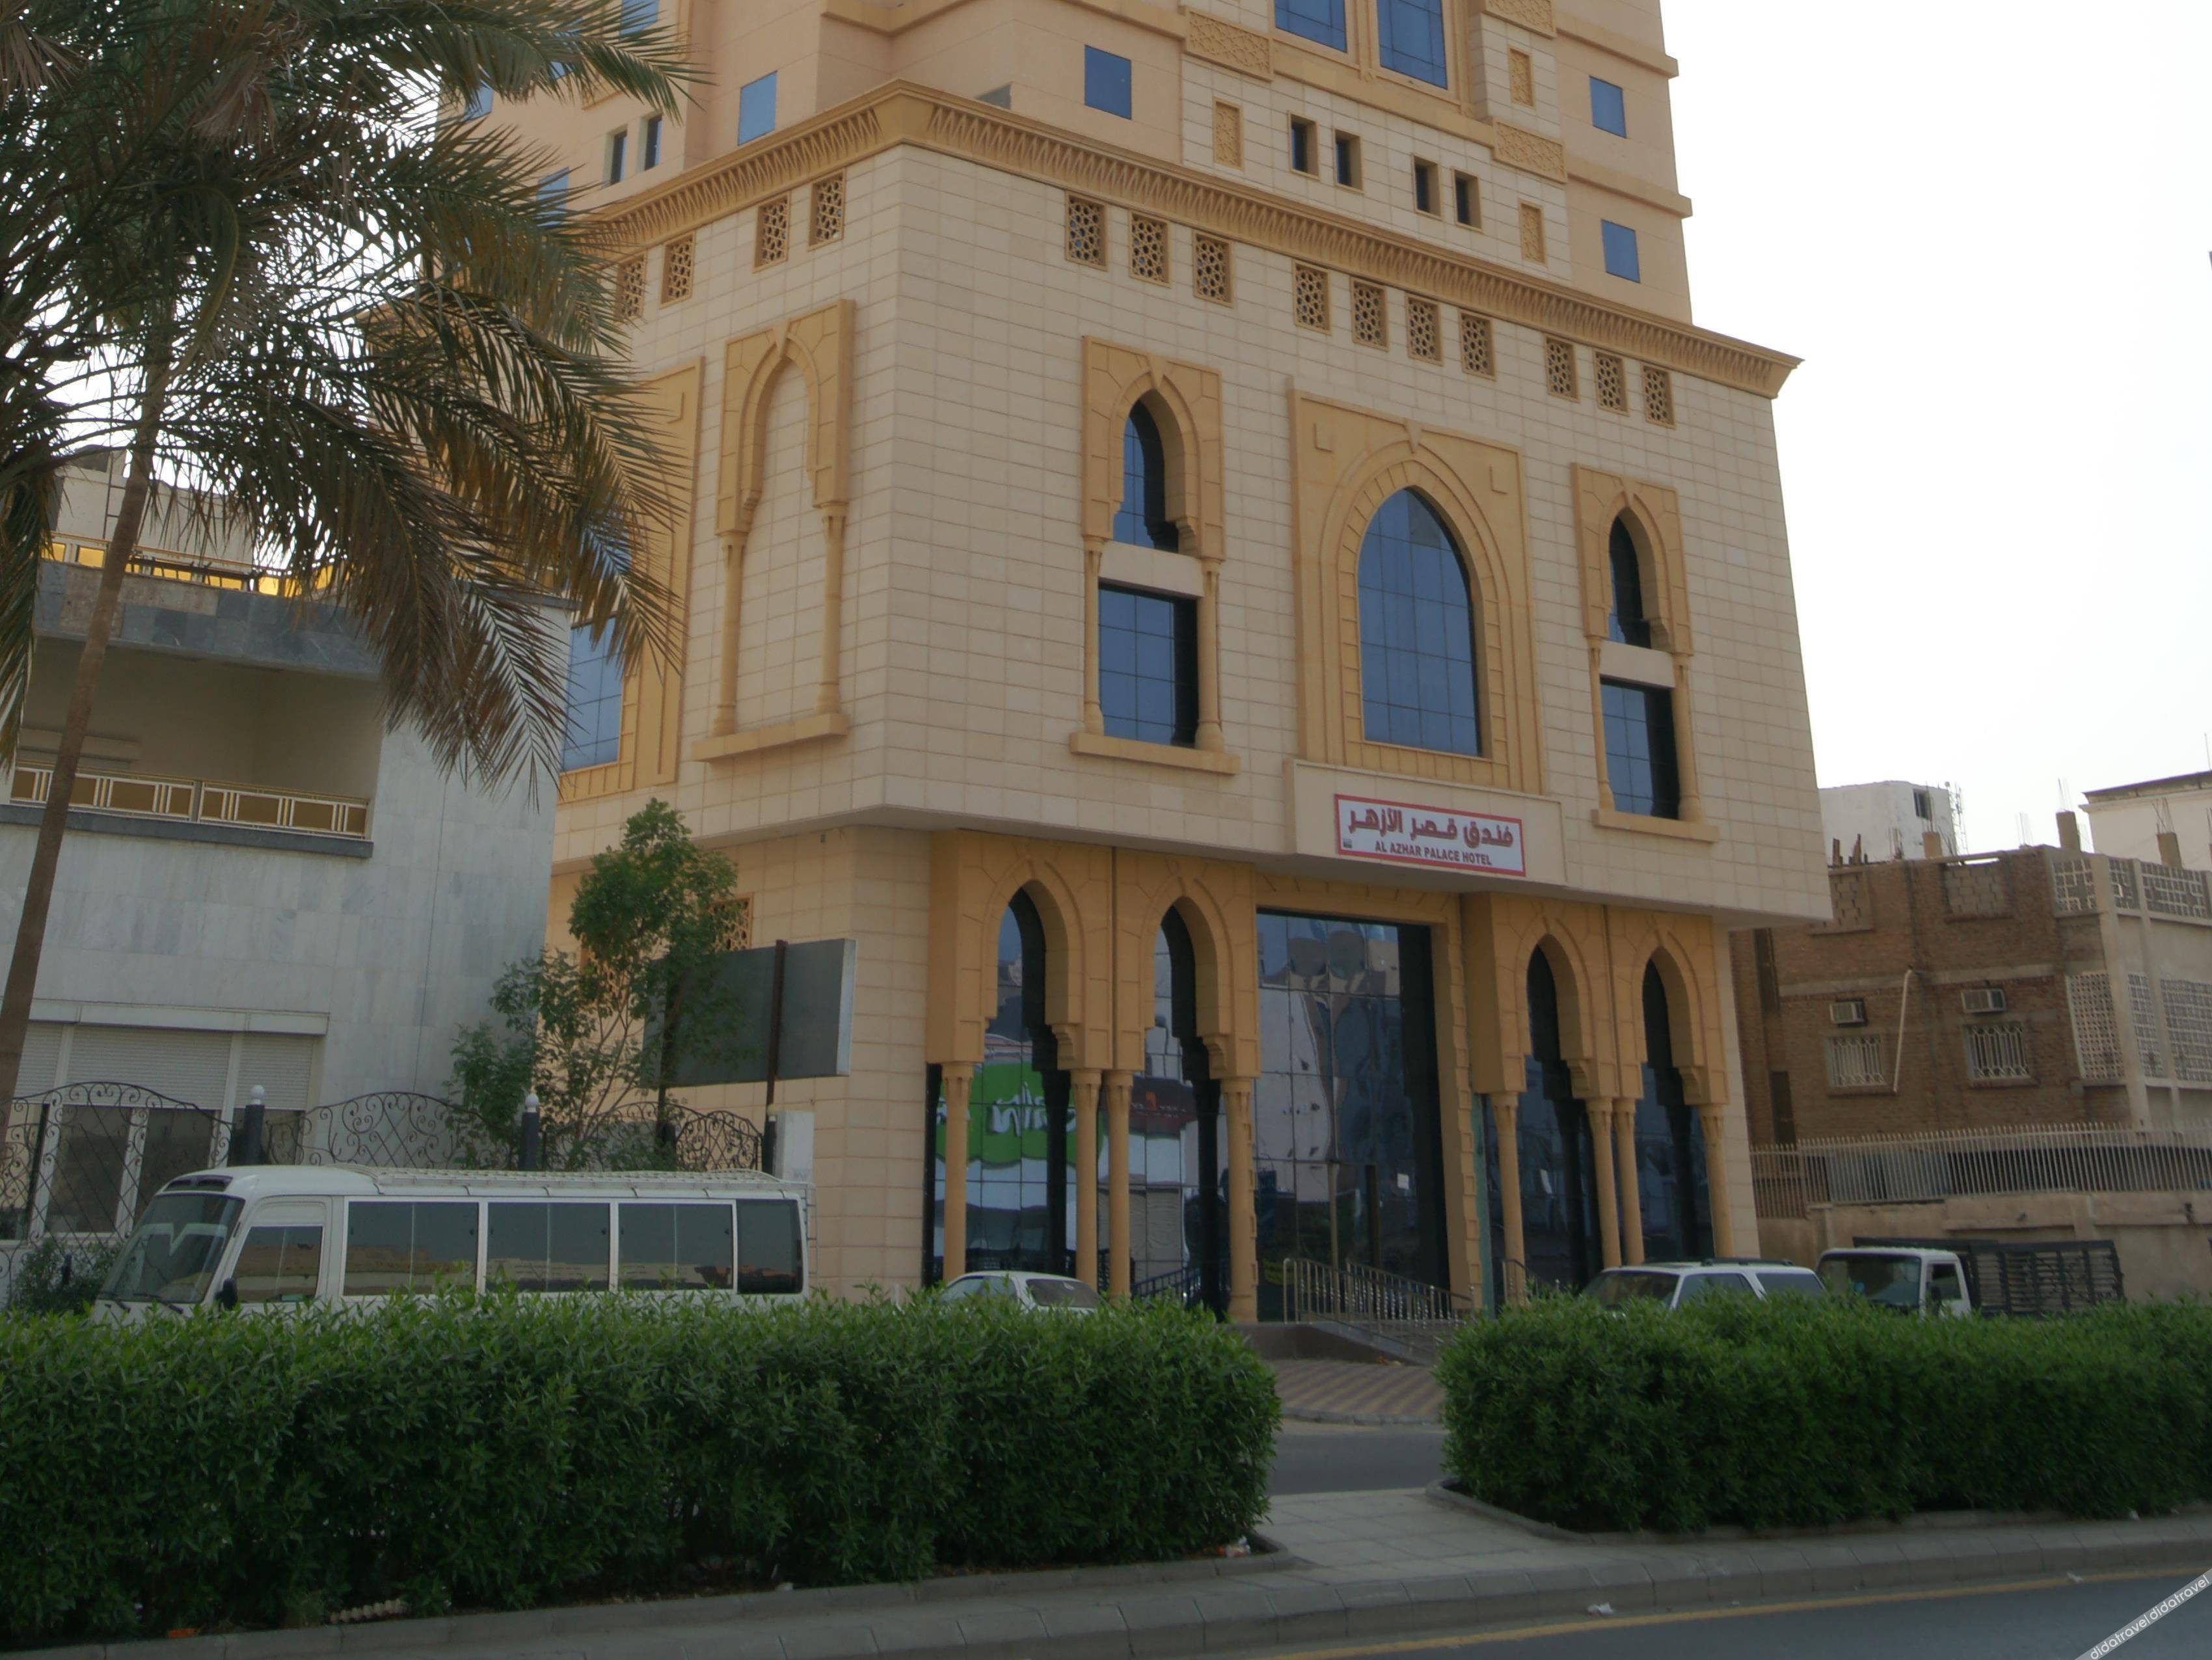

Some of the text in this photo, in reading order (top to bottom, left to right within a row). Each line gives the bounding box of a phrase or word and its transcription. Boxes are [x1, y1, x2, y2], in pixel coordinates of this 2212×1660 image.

[1410, 817, 1457, 841] قصر
[1464, 821, 1513, 848] فندق
[1375, 841, 1492, 865] AL AZHAR PALACE HOTEL
